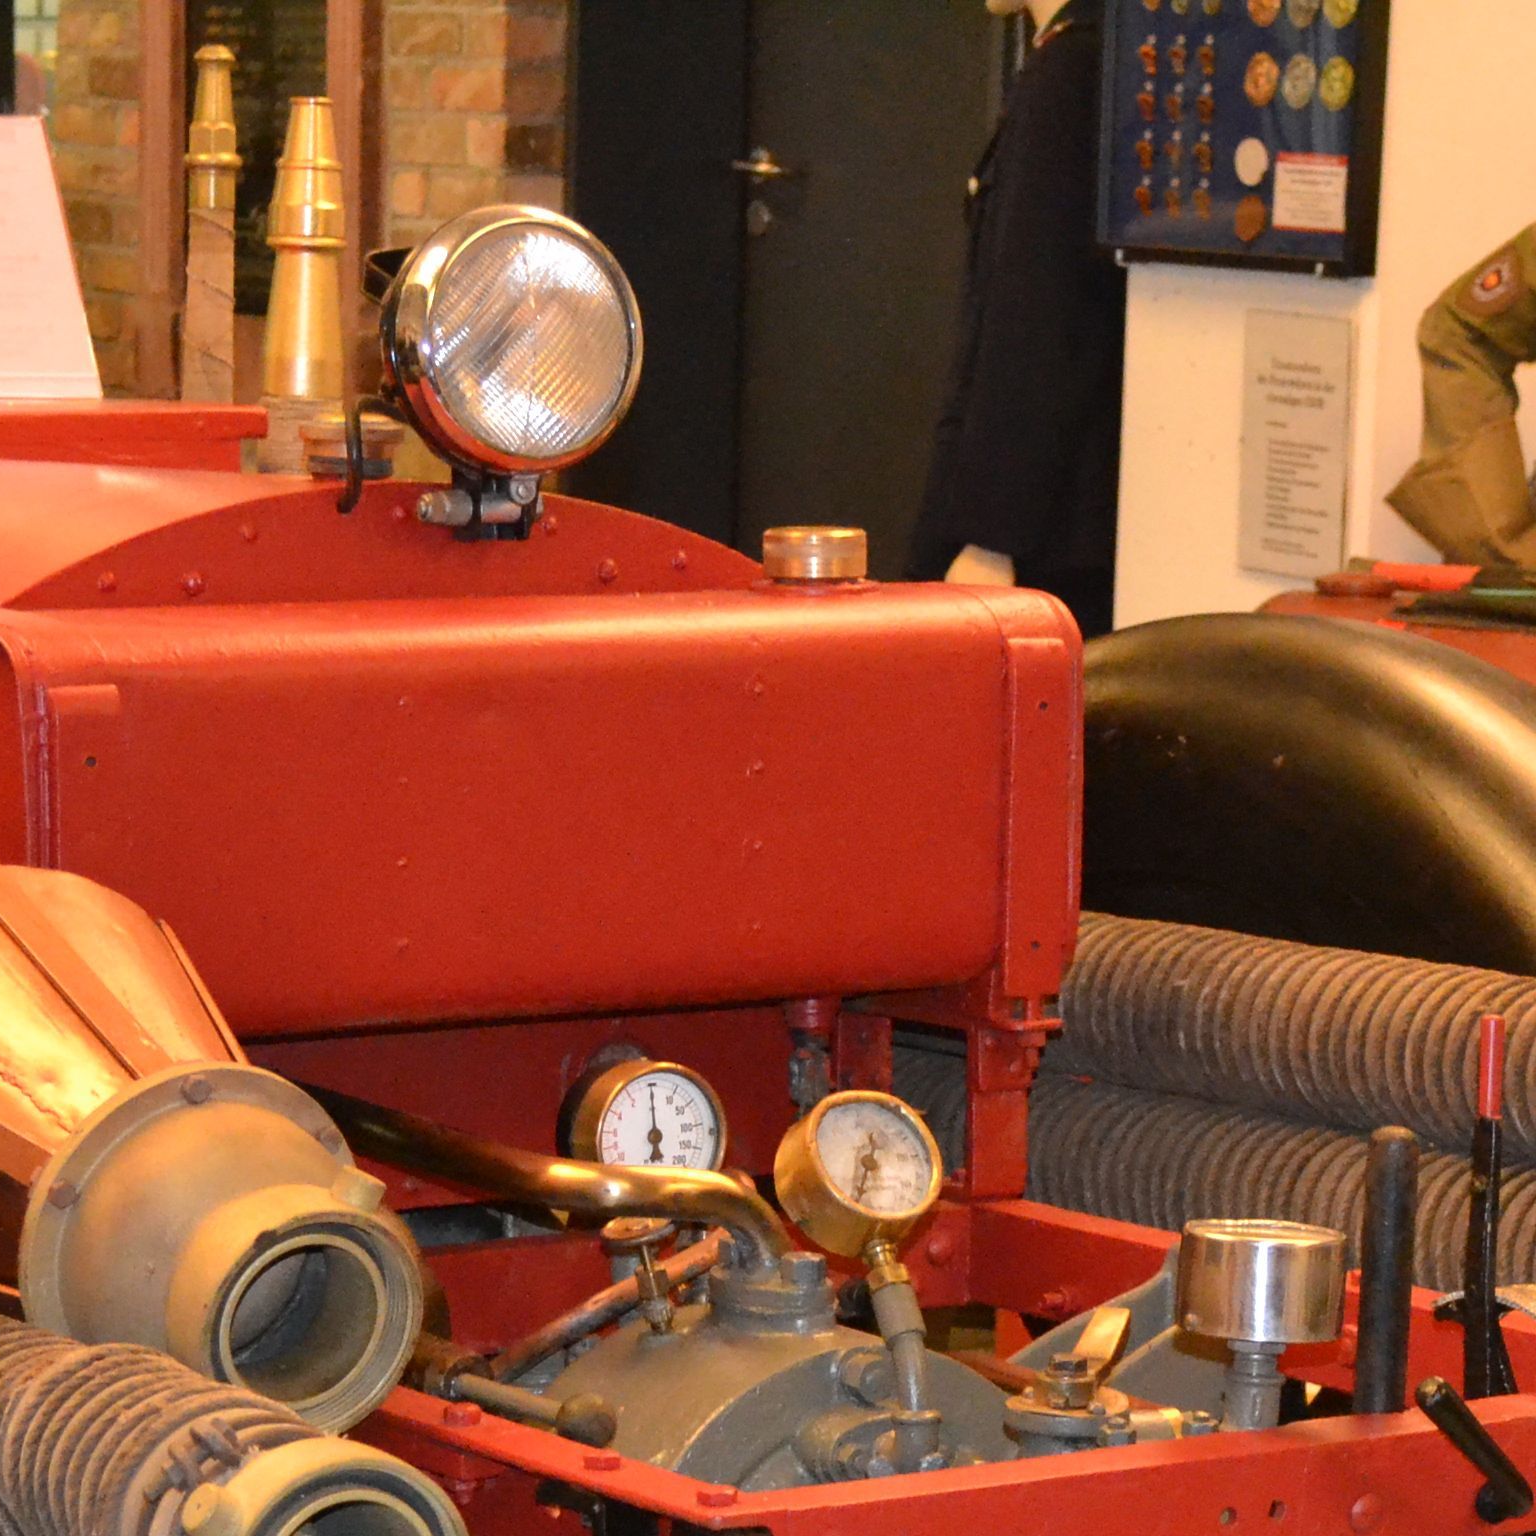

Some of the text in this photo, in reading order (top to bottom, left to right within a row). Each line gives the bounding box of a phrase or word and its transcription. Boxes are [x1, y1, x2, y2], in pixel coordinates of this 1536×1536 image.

[666, 1095, 674, 1105] 10
[675, 1105, 685, 1116] 50
[680, 1122, 693, 1133] 100
[679, 1139, 692, 1150] 150
[672, 1154, 687, 1166] 200
